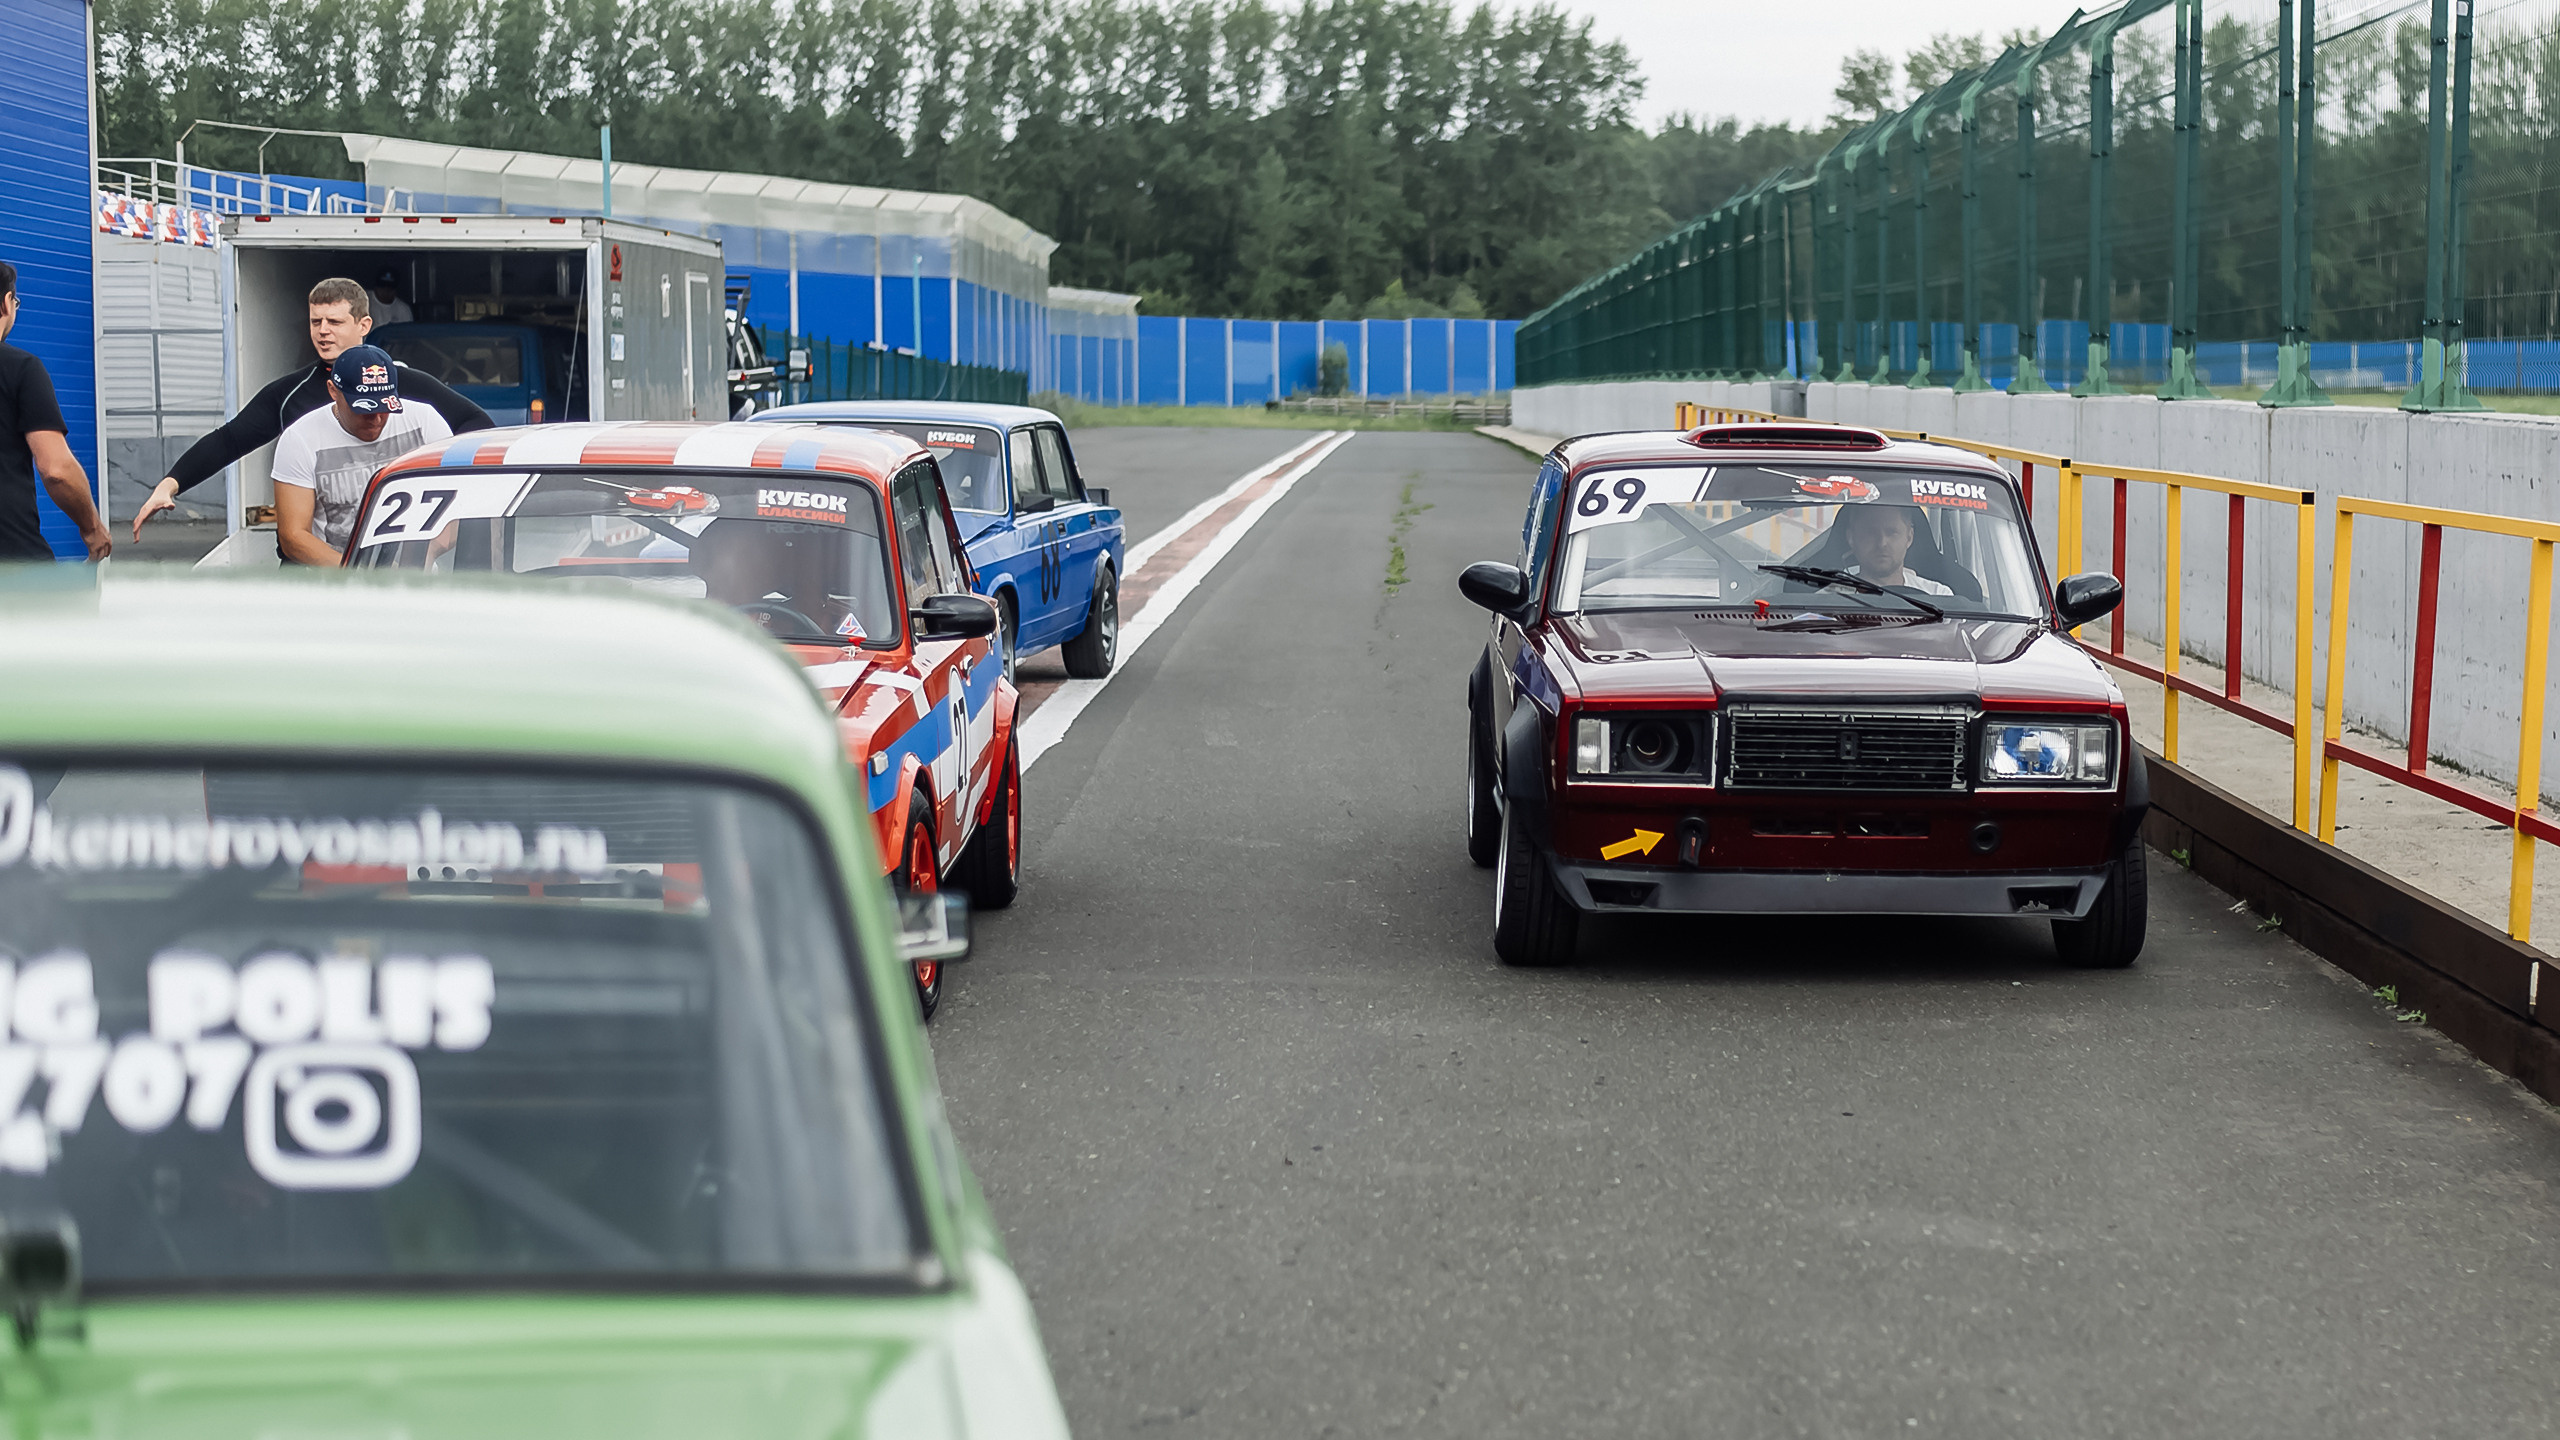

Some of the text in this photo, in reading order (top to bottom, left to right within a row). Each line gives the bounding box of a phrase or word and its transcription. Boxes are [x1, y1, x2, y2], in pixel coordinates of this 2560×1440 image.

[927, 431, 976, 444] КУБОК
[758, 490, 848, 512] КУБОК
[1577, 477, 1646, 517] 69
[1911, 479, 1987, 500] КУБОК
[1912, 495, 1988, 510] КЛАССИКИ
[373, 489, 458, 537] 27
[757, 507, 846, 524] КЛАССИКИ
[1039, 521, 1060, 605] 68
[954, 696, 967, 794] 27
[147, 950, 496, 1051] POLIS
